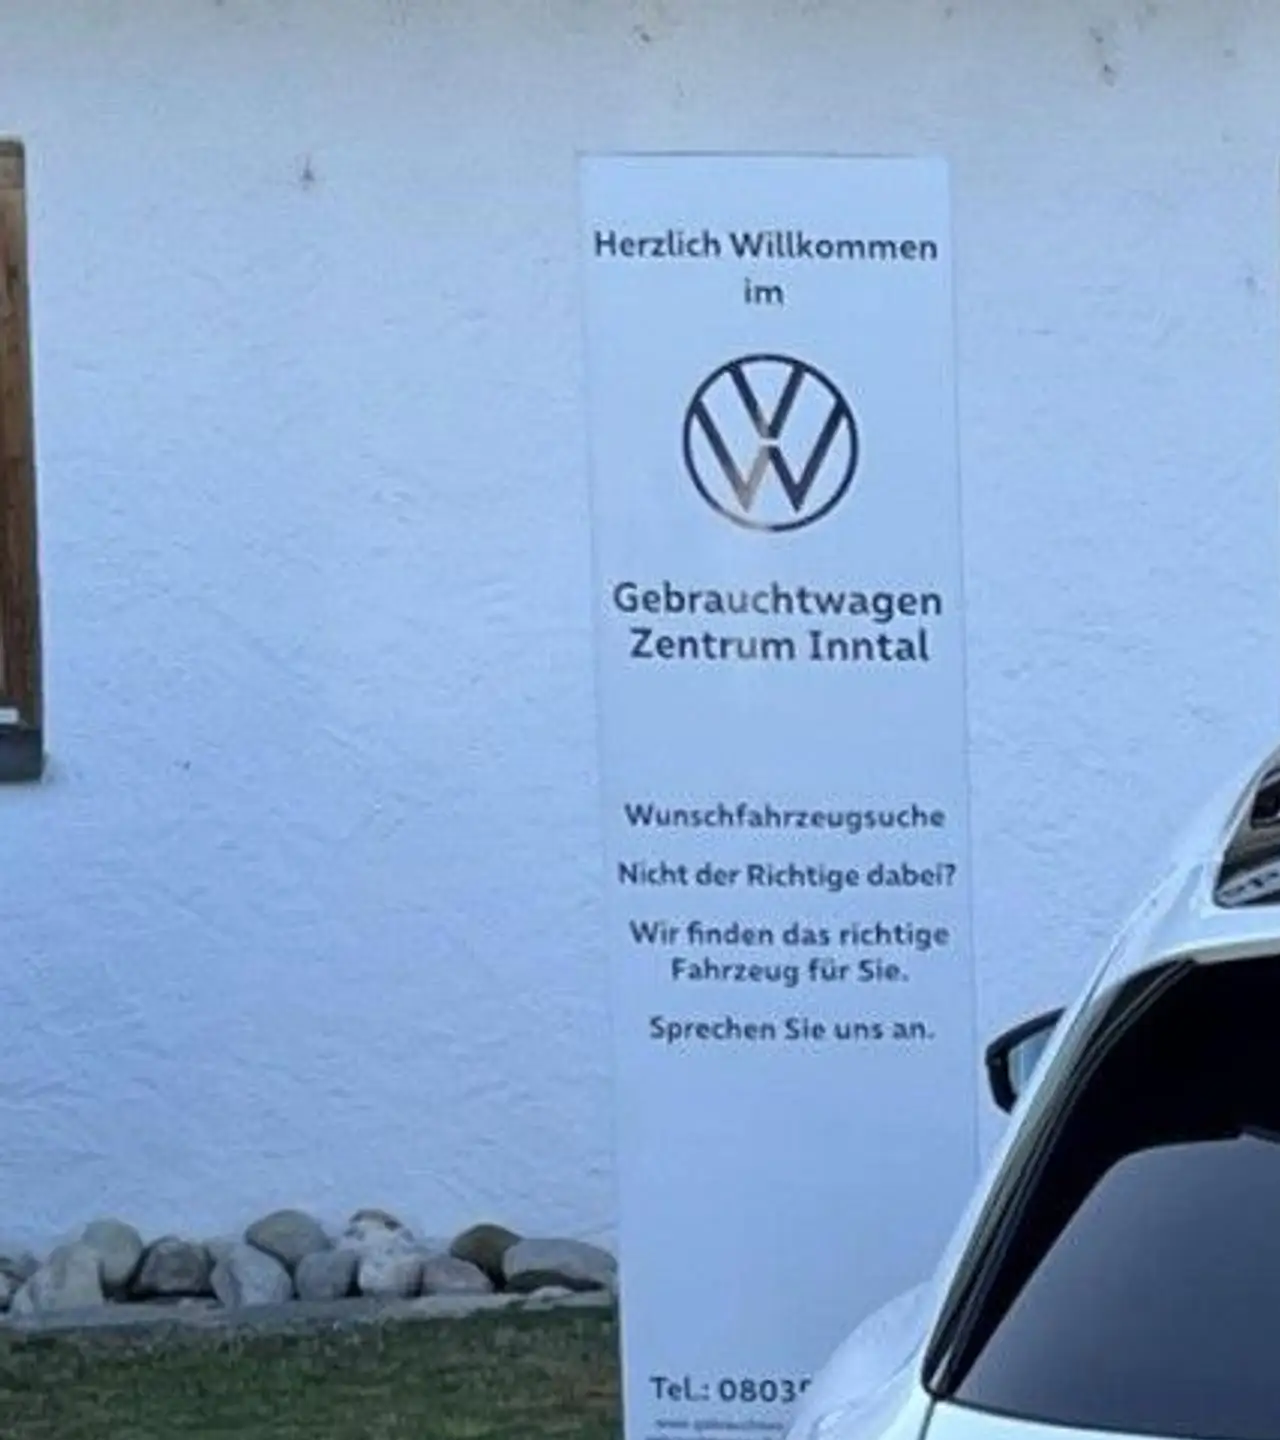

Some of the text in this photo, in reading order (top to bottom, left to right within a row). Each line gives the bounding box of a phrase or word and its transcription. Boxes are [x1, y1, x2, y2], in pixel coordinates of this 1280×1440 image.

[594, 228, 938, 261] Herzlich Willkommen
[744, 277, 784, 305] im
[613, 580, 942, 625] Gebrauchtwagen
[630, 620, 930, 662] Zentrum Inntal
[623, 802, 946, 835] Wunschfahrzeugsuche
[618, 860, 957, 893] Nicht der Richtige dabei?
[629, 920, 950, 952] Wir finden das richtige
[671, 956, 909, 989] Fahrzeug für Sie.
[649, 1015, 935, 1045] Sprechen Sie uns an.
[649, 1375, 710, 1402] Tel.:
